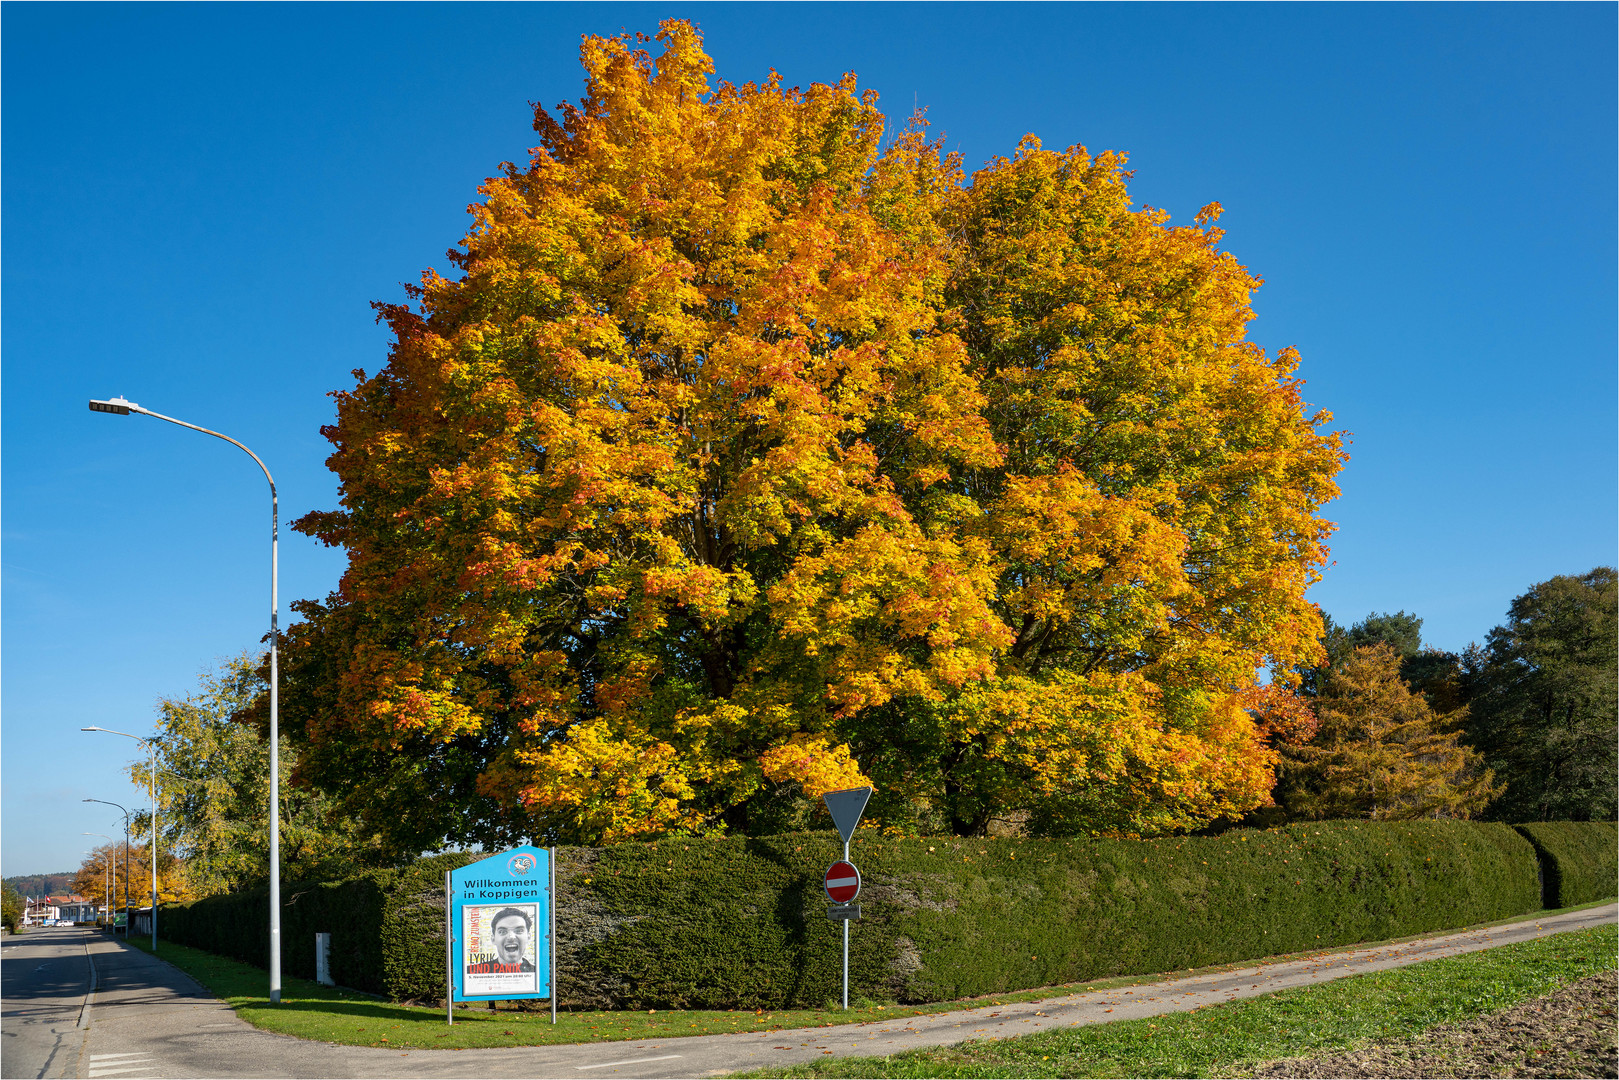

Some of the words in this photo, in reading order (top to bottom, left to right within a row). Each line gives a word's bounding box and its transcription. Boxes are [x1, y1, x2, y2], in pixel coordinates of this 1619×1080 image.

[464, 879, 537, 888] Willkommen
[464, 890, 475, 899] in
[480, 889, 537, 900] Koppigen
[470, 907, 480, 936] ZUMSTEIN
[470, 936, 480, 953] REMO
[469, 953, 495, 964] LYRIK
[469, 963, 490, 974] UND
[493, 962, 522, 974] PANIK
